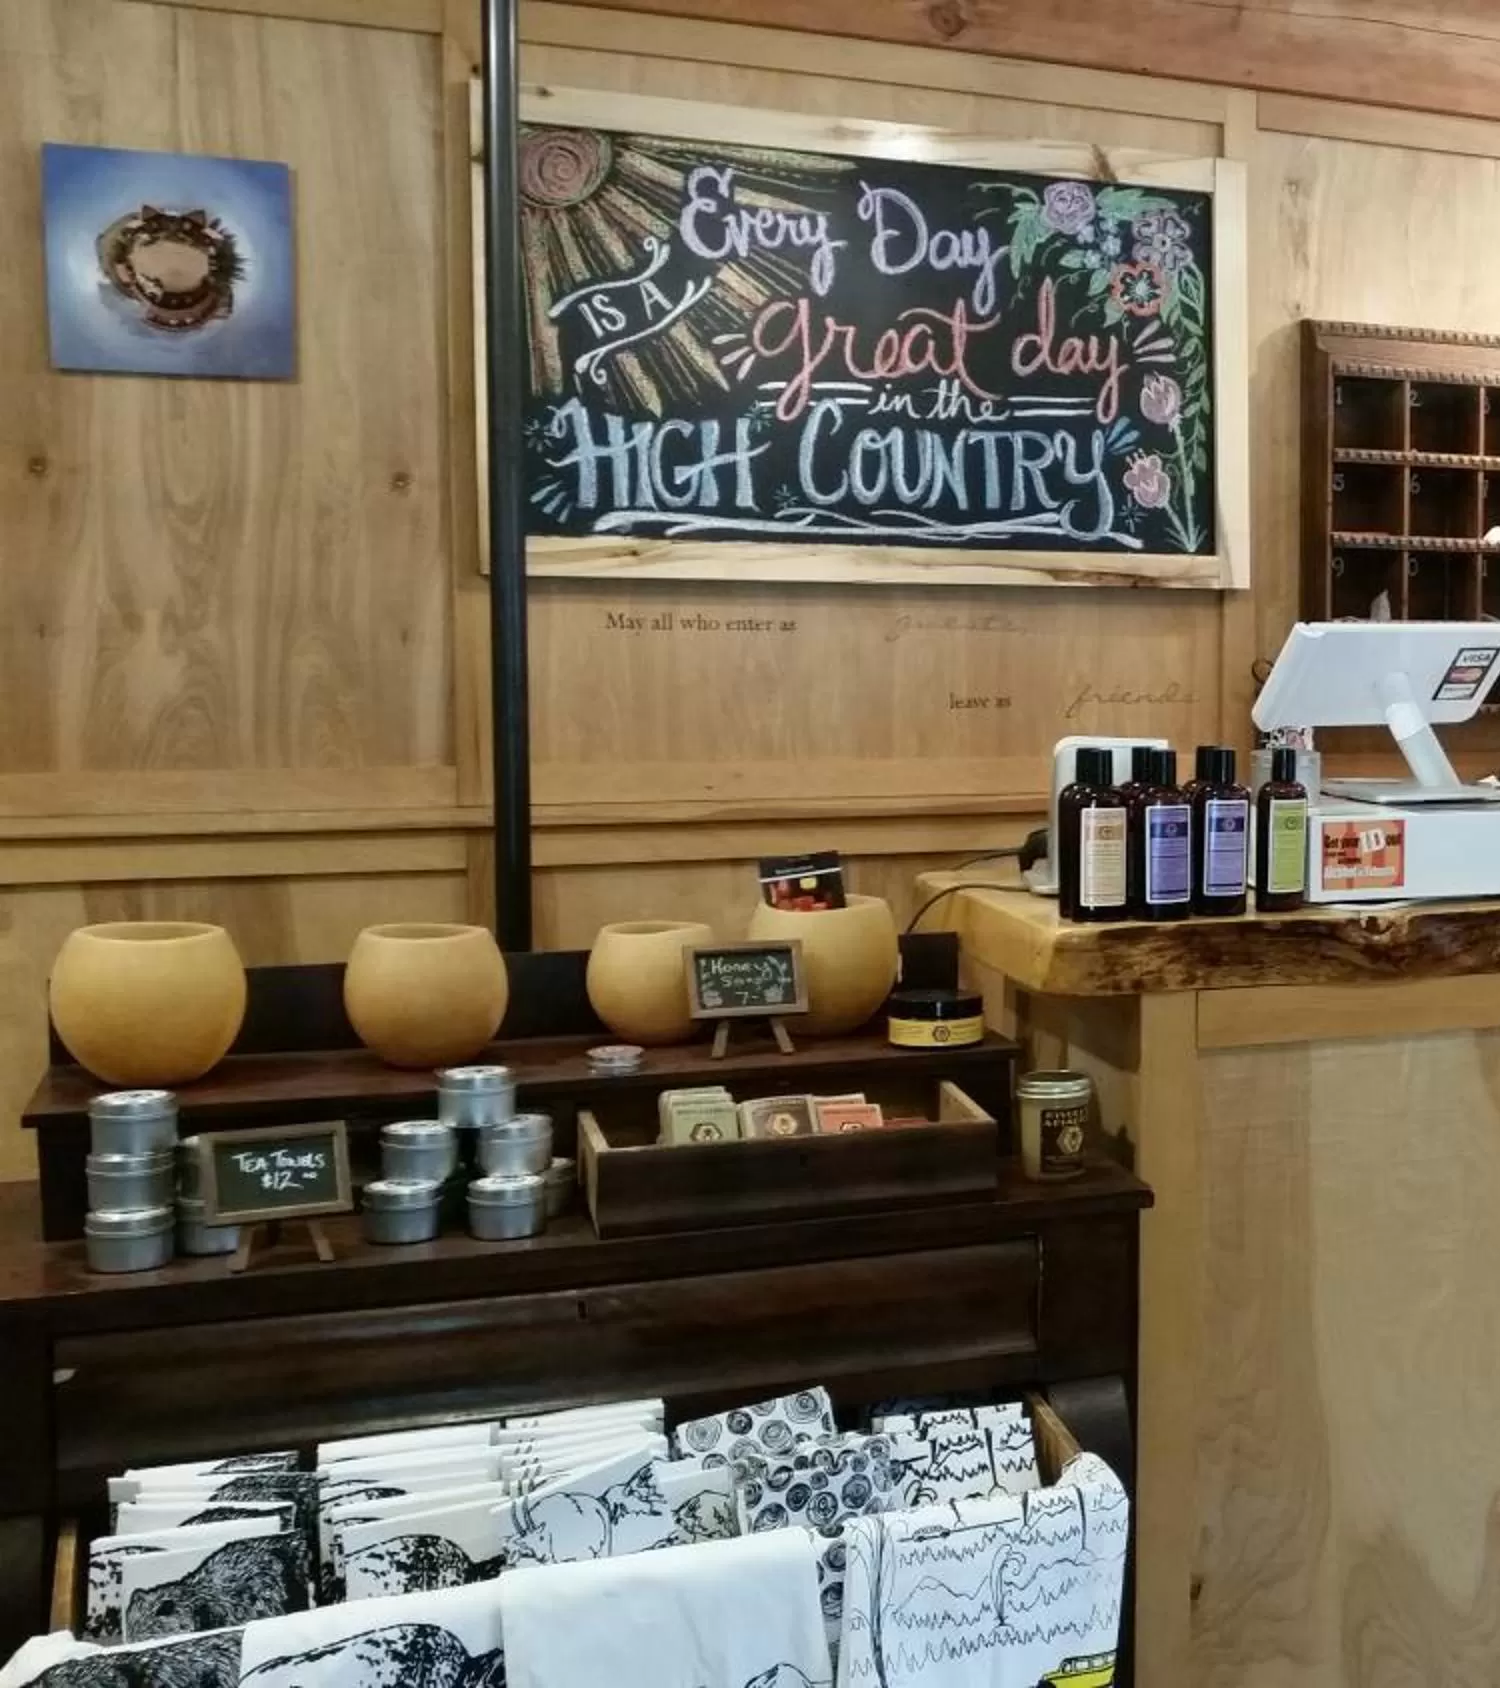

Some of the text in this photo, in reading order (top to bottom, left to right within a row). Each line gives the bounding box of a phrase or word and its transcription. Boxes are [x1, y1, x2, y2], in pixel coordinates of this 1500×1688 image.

[680, 165, 1013, 314] Every Day
[580, 281, 673, 338] IS A
[752, 277, 1135, 422] great day
[869, 380, 1016, 423] in the
[546, 399, 1112, 536] HIGH COUNTRY
[605, 611, 646, 637] May
[651, 612, 673, 631] all
[680, 613, 720, 632] who
[725, 616, 772, 632] enter
